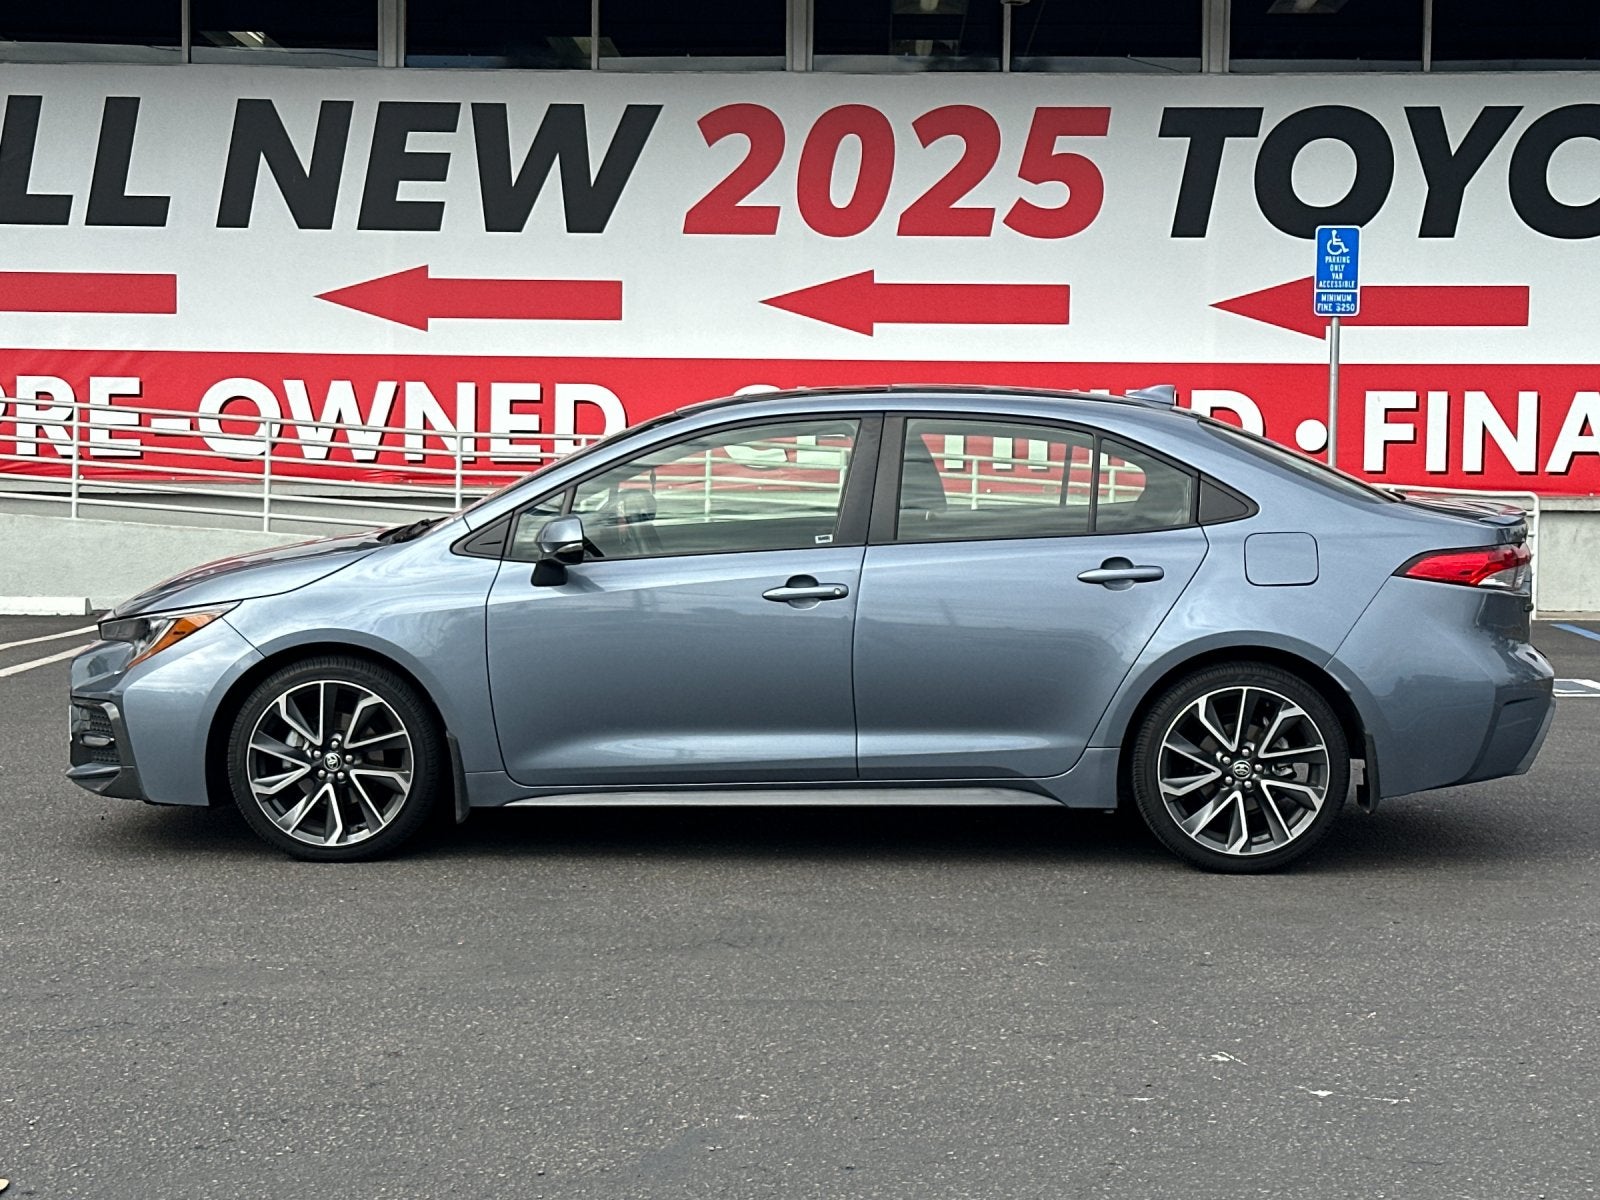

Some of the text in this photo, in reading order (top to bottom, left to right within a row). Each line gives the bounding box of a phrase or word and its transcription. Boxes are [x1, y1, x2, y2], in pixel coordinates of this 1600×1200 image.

[0, 95, 1600, 240] LL NEW 2025 TOYO
[1325, 255, 1351, 264] PARKING
[1329, 264, 1345, 272] ONLY
[1331, 272, 1343, 280] VAN
[1318, 280, 1356, 289] ACCESSIBLE
[1321, 293, 1352, 302] MINIMUM
[1317, 302, 1356, 312] FINE $250
[0, 375, 627, 463] RE-OWNED
[1363, 390, 1600, 473] FINA
